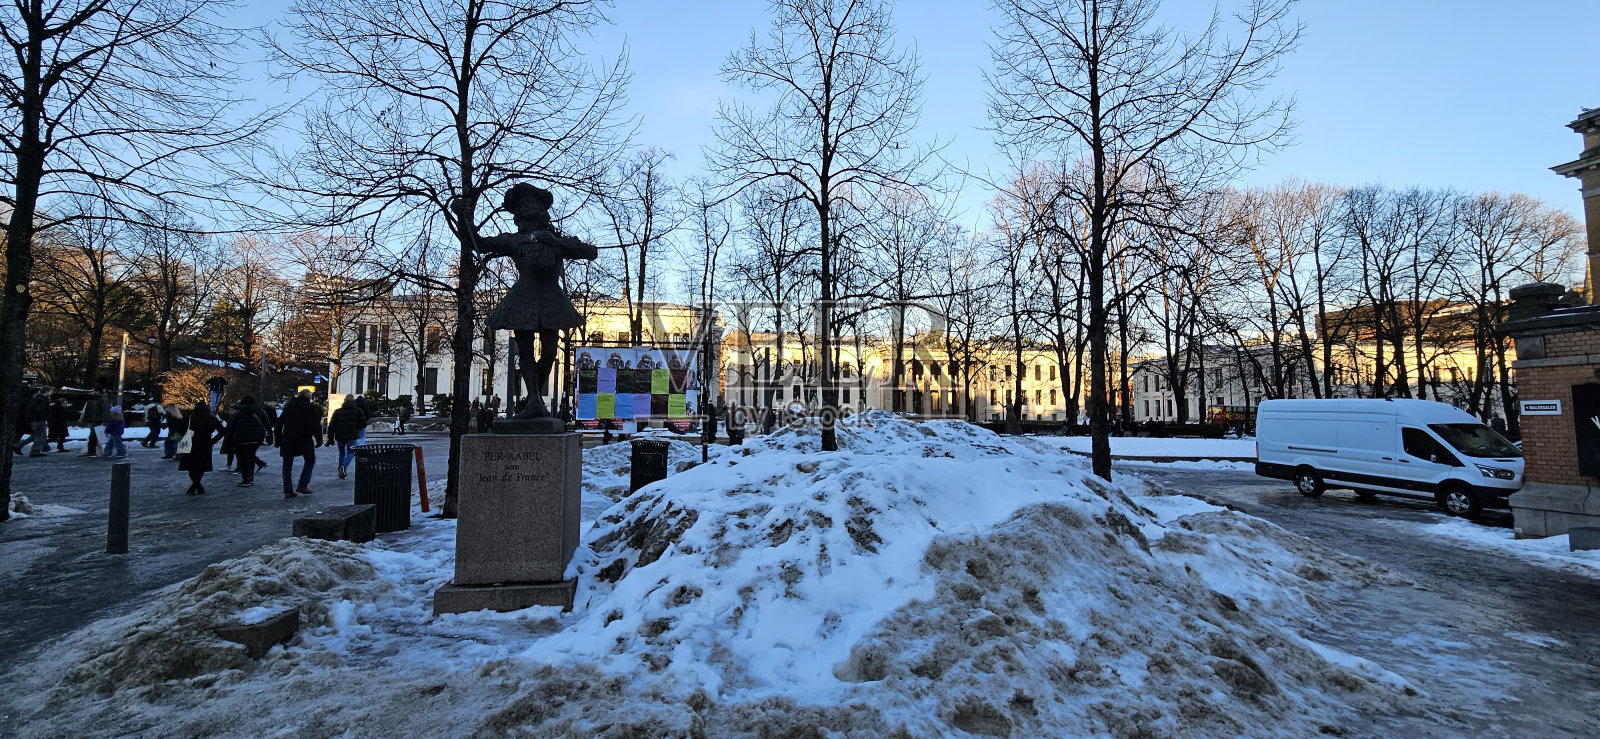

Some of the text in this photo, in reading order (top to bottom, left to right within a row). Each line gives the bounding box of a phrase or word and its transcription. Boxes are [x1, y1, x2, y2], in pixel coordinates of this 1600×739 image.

[484, 452, 542, 461] PER AABEL
[501, 471, 512, 481] de
